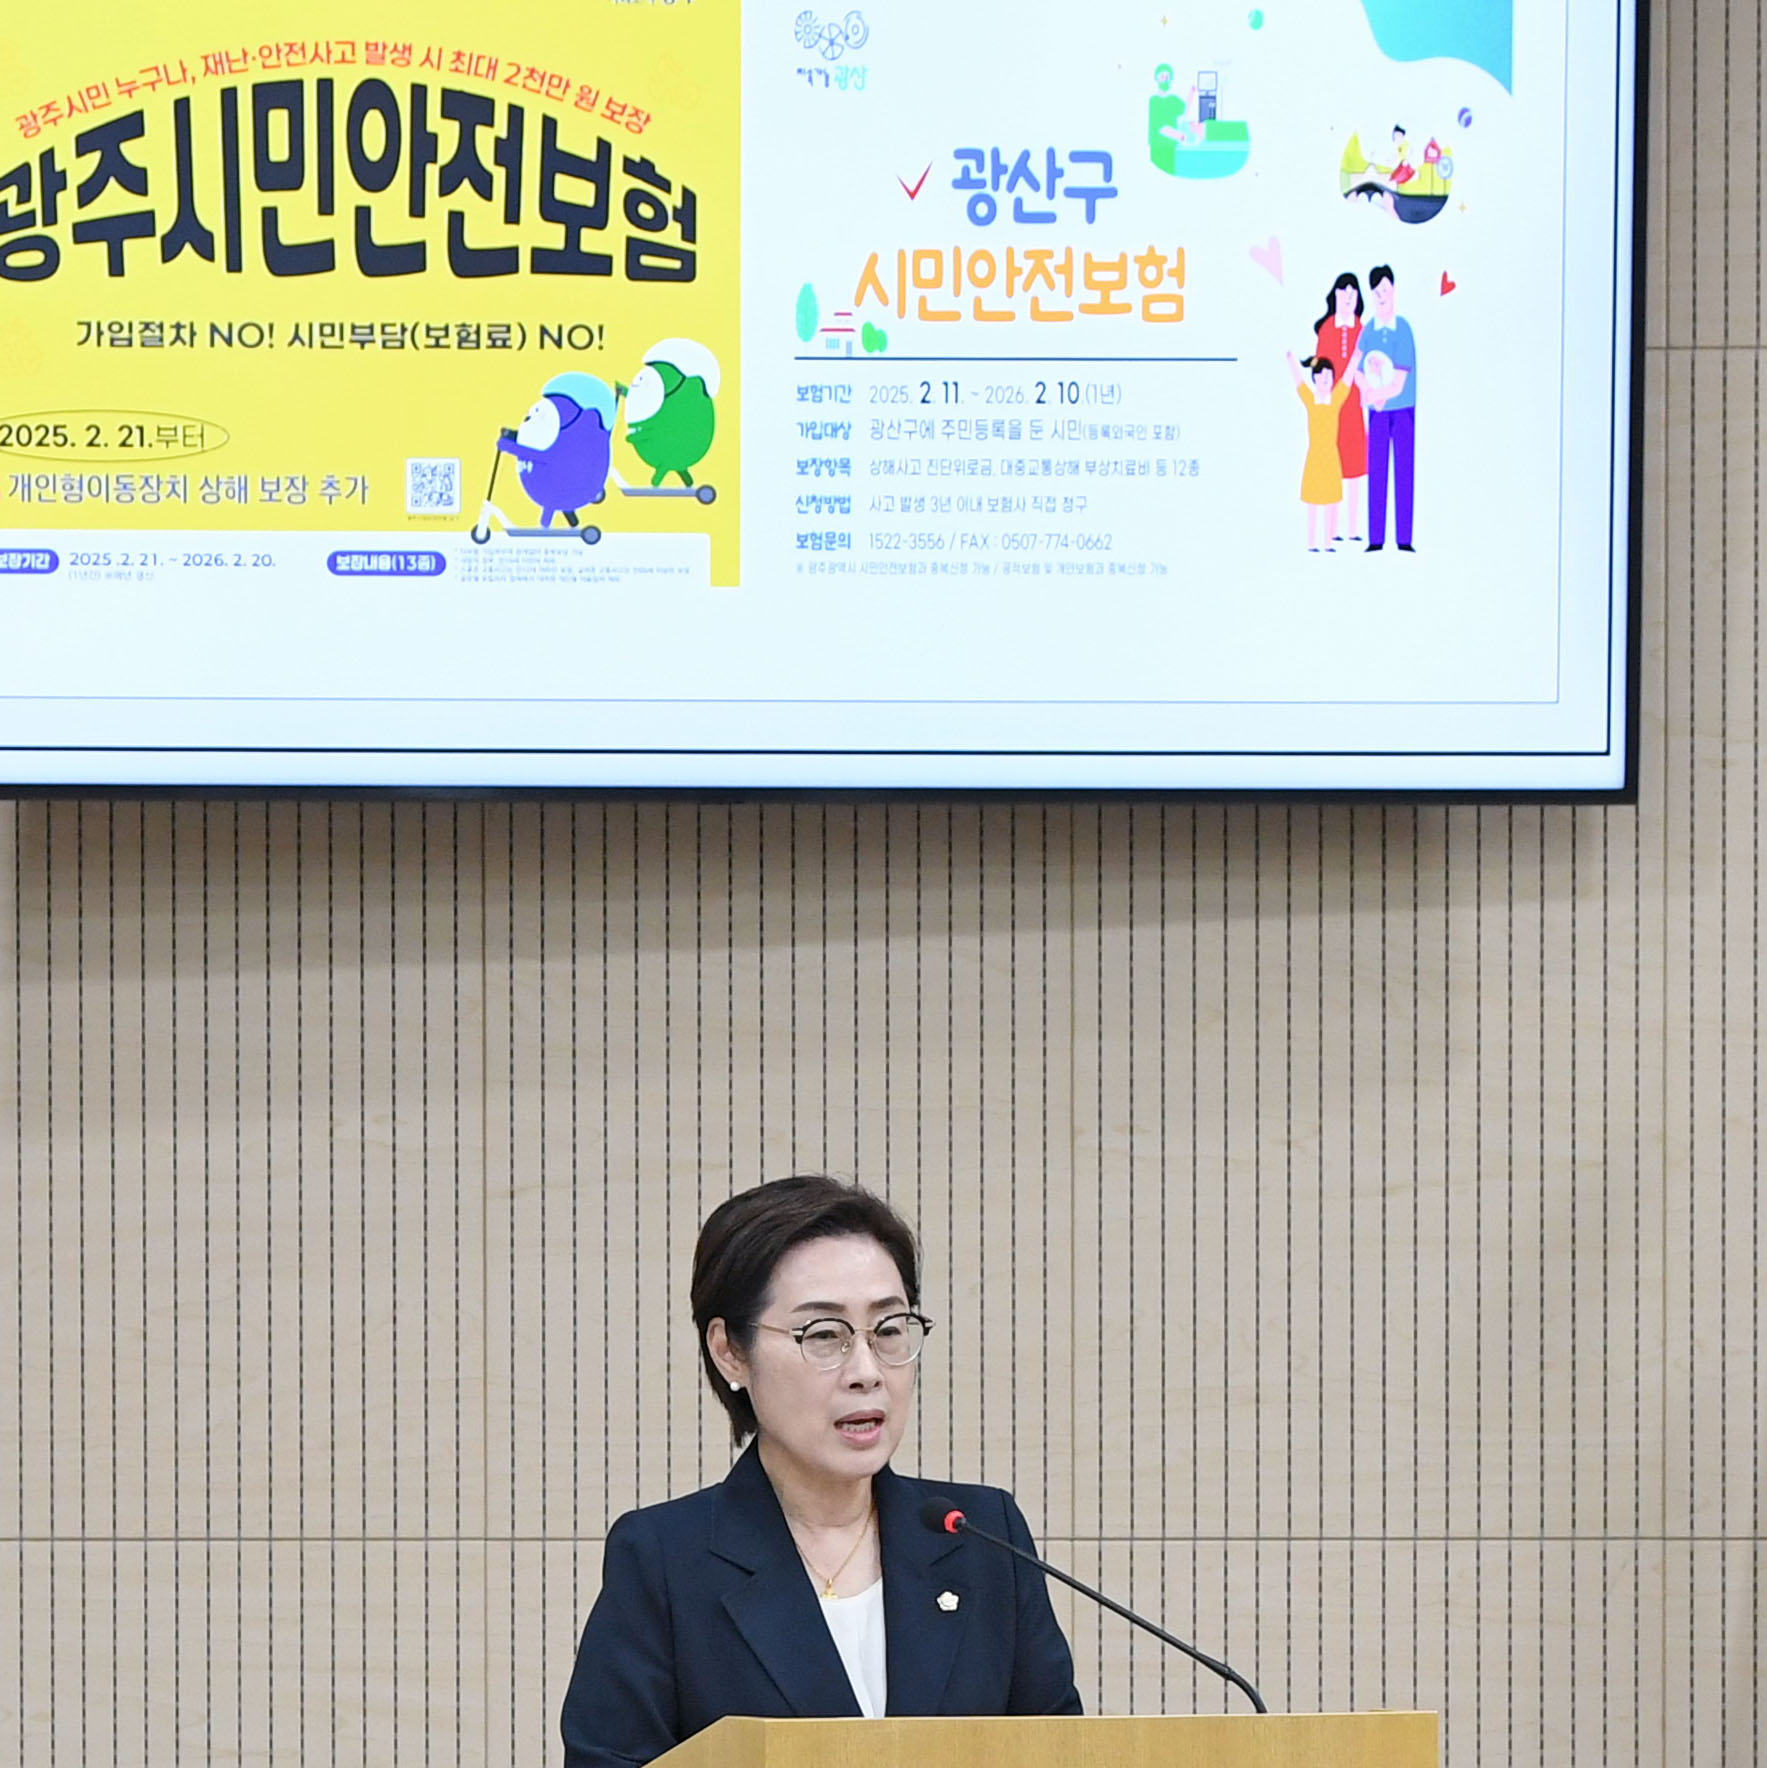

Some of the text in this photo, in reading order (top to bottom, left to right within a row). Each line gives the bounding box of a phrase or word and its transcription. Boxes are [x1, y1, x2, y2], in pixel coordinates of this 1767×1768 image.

[16, 82, 112, 139] 광주시민
[115, 60, 195, 100] 누구나,
[364, 41, 412, 67] 발생
[419, 46, 443, 71] 시
[449, 50, 499, 81] 최대
[503, 62, 571, 102] 2천만
[574, 84, 600, 113] 원
[601, 97, 651, 135] 보장
[951, 145, 1118, 227] 광산구
[854, 244, 1187, 324] 시민안전보험
[76, 320, 605, 352] 가입절차 NO! 시민부담(보험료) NO!
[796, 384, 852, 404] 보험기간
[85, 424, 107, 449] 2.
[118, 424, 206, 451] 21.부터
[797, 420, 852, 441] 가입대상
[870, 418, 934, 441] 광산구에
[941, 418, 1022, 441] 주민등록을
[796, 457, 852, 477] 보장항목
[8, 474, 369, 506] 개인형이동장치 상해 보장 추가
[795, 494, 851, 514] 신청방법
[870, 495, 895, 513] 사고
[796, 531, 851, 551] 보험문의
[870, 533, 944, 550] 1522-3556
[960, 533, 990, 550] FAX
[183, 553, 228, 567] 2026.
